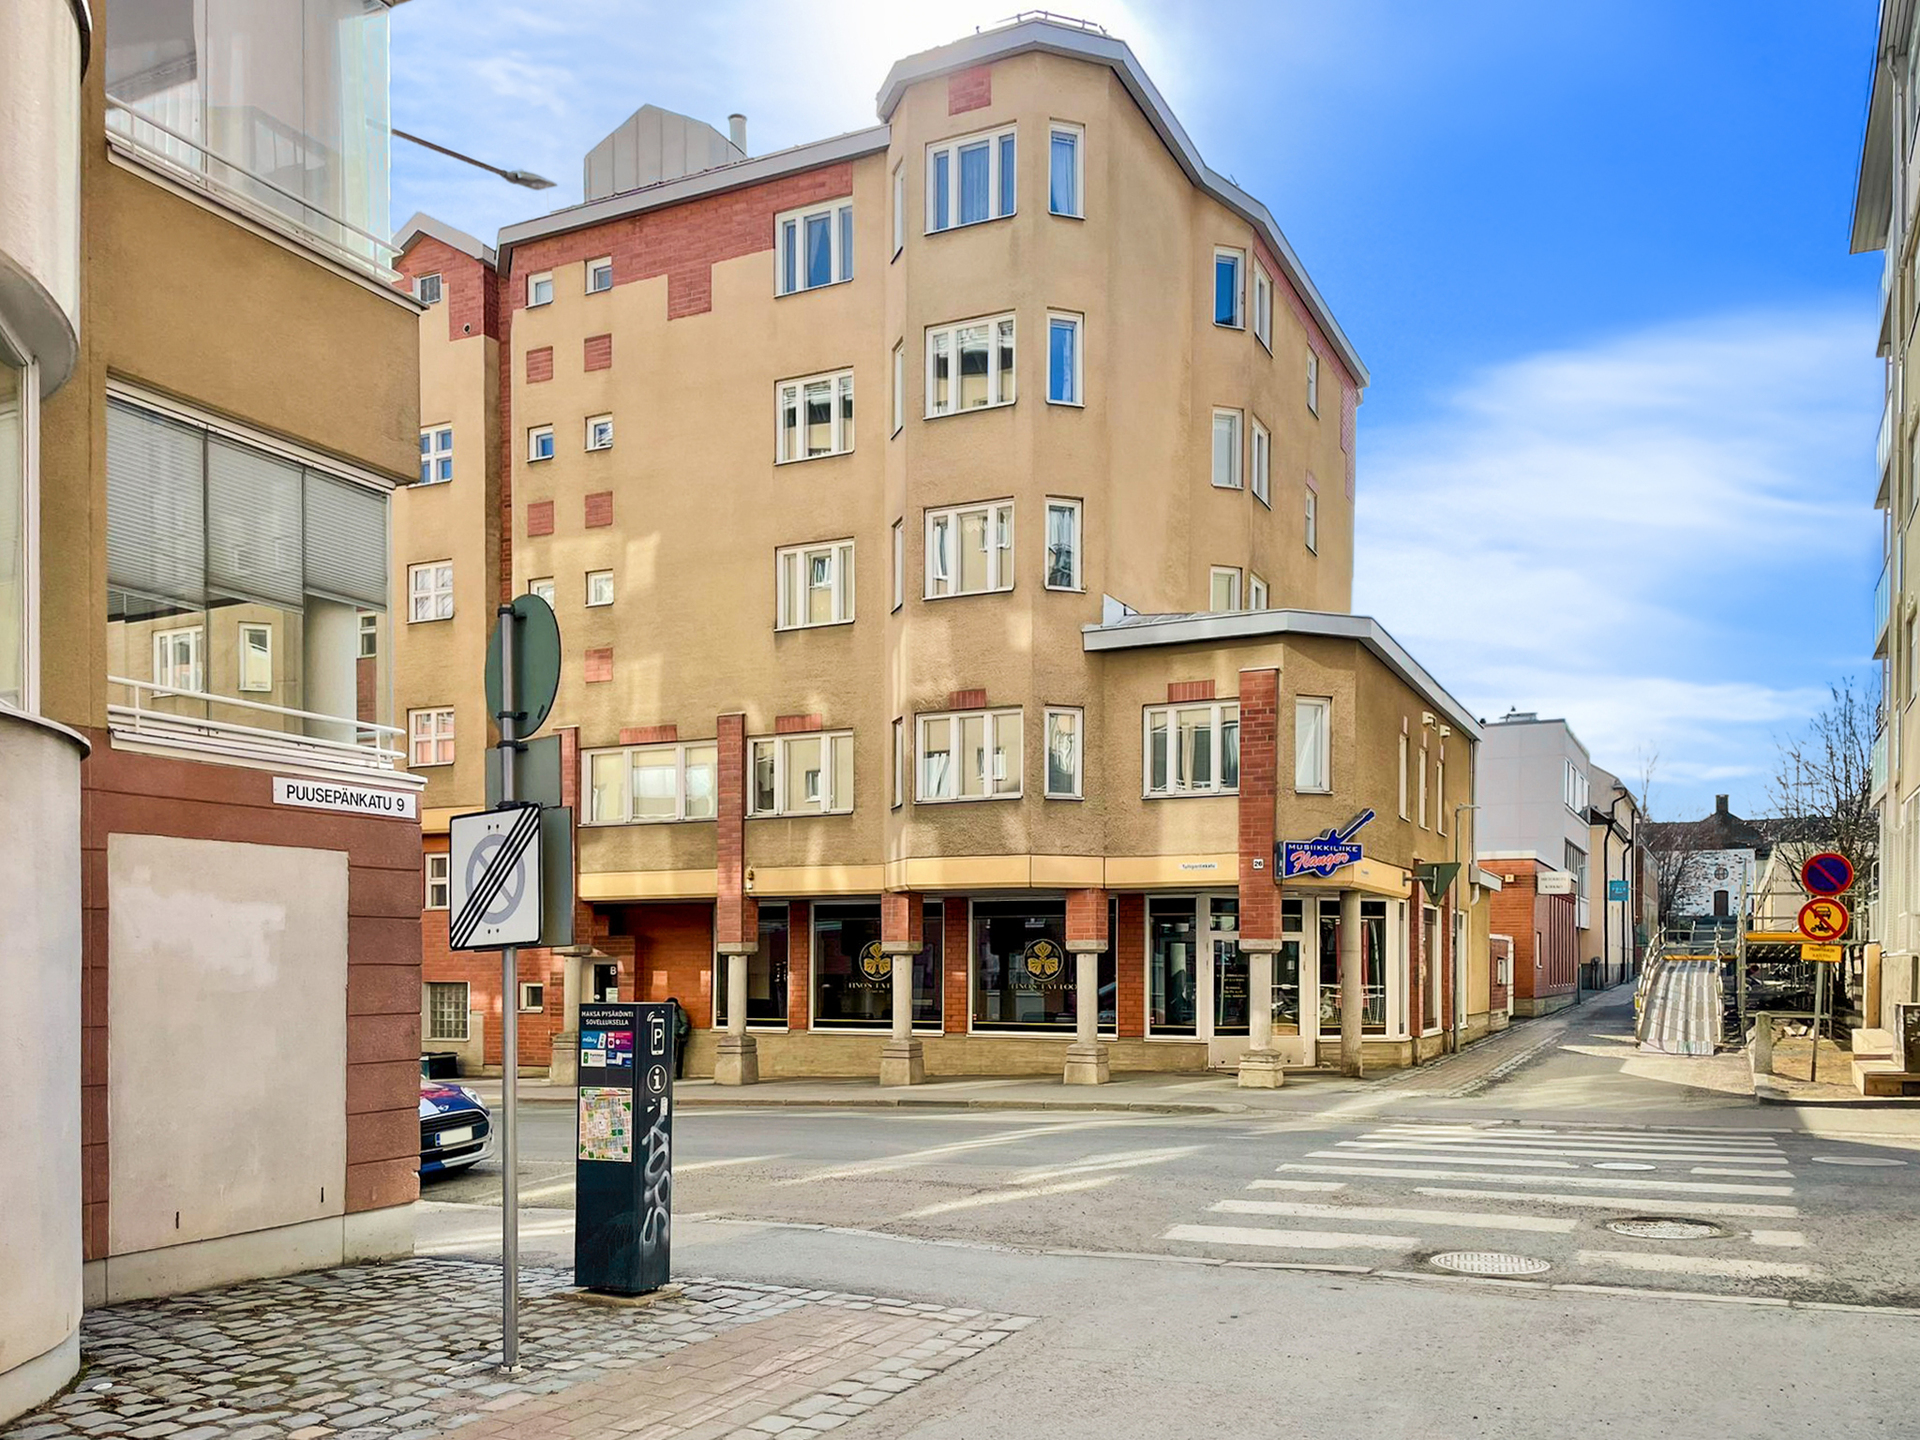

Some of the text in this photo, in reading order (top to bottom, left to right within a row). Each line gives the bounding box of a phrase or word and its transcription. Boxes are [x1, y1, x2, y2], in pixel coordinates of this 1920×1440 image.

[286, 784, 405, 812] PUUSEPÄNKATU 9
[1288, 843, 1359, 853] MUSIIKKILIIKE
[1290, 851, 1349, 873] Flanger
[610, 966, 617, 976] B
[601, 1009, 634, 1018] PYSÄKÖINTI
[585, 1018, 629, 1026] SOVELLUKSELLA
[654, 1028, 663, 1045] P
